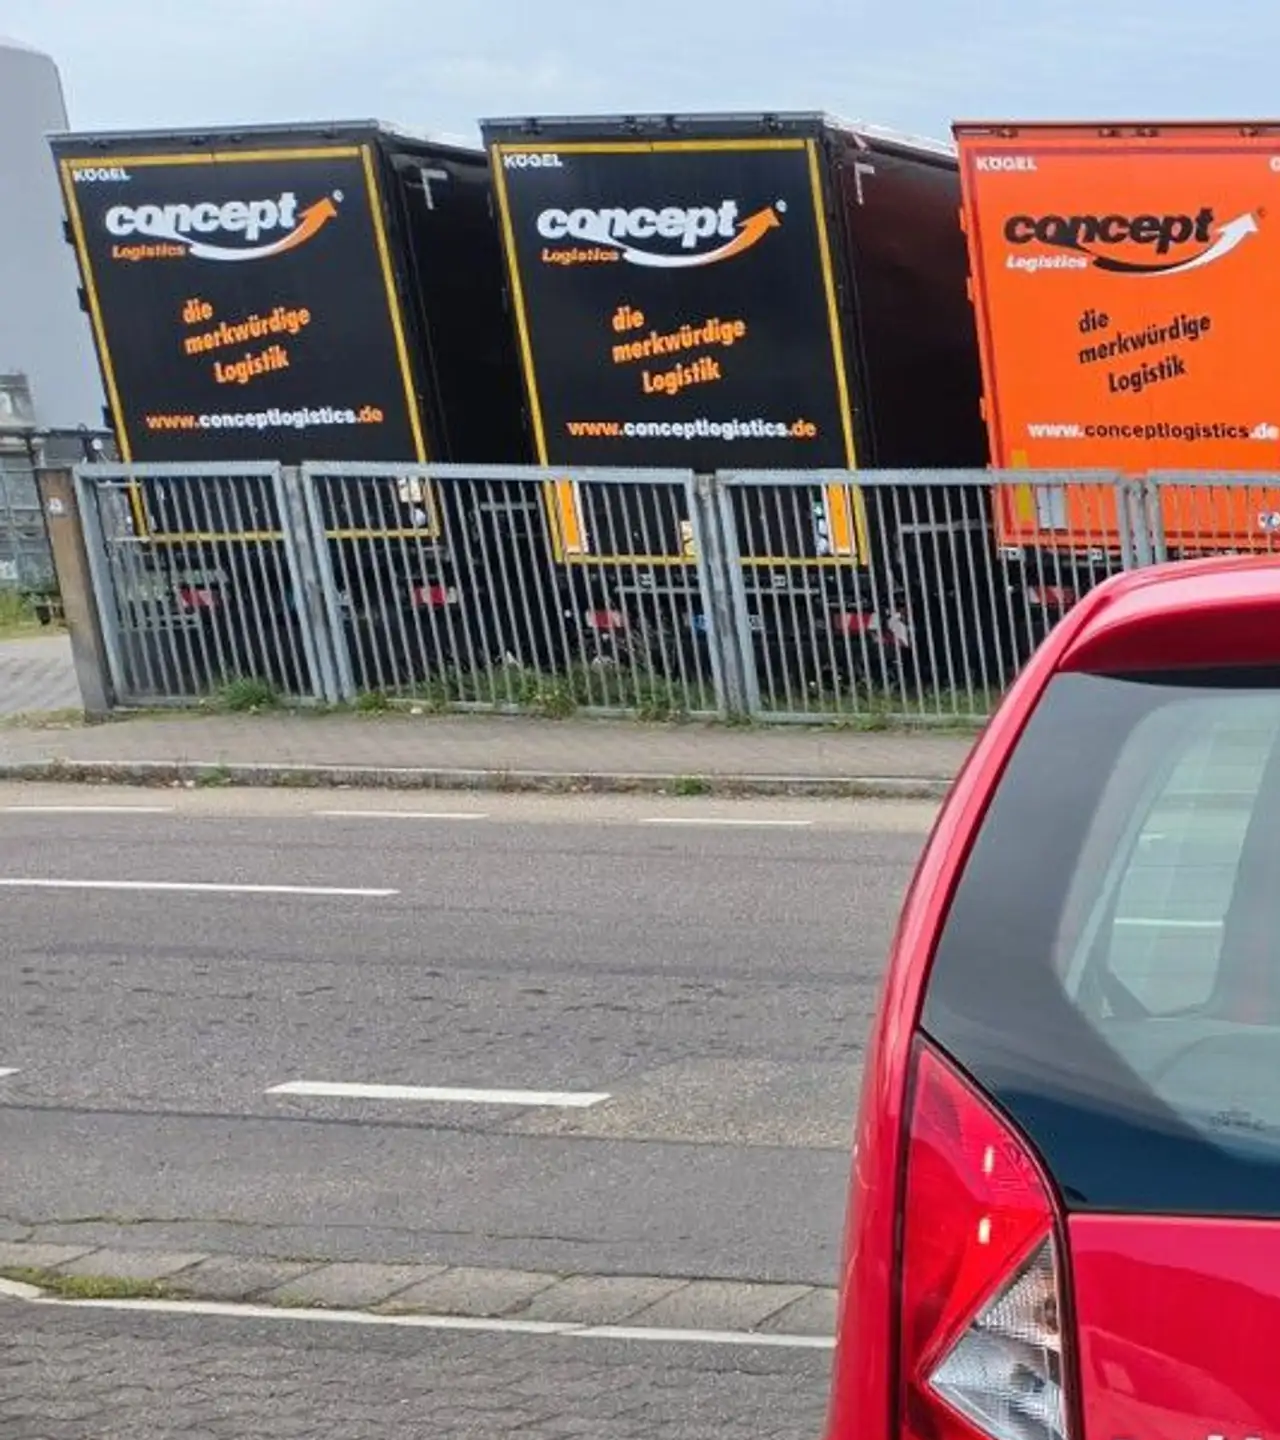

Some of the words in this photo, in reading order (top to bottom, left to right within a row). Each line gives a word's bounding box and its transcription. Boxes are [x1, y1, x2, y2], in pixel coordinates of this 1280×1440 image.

[105, 192, 297, 240] concept
[537, 200, 738, 248] concept
[1004, 208, 1213, 254] concept
[113, 244, 185, 260] Logistics
[542, 248, 618, 265] Logistics
[1006, 254, 1087, 272] Logistics
[183, 299, 213, 324] die
[612, 306, 644, 332] die
[1079, 309, 1109, 334] die
[185, 306, 310, 354] merkwürdige
[612, 318, 746, 363] merkwürdige
[1078, 314, 1211, 364] merkwürdige
[214, 346, 289, 383] Logistik
[642, 357, 720, 394] Logistik
[1109, 355, 1185, 393] Logistik
[146, 406, 383, 429] www.conceptlogistics.de
[566, 419, 817, 440] www.conceptlogistics.de
[1027, 422, 1280, 440] www.conceptlogistics.de
